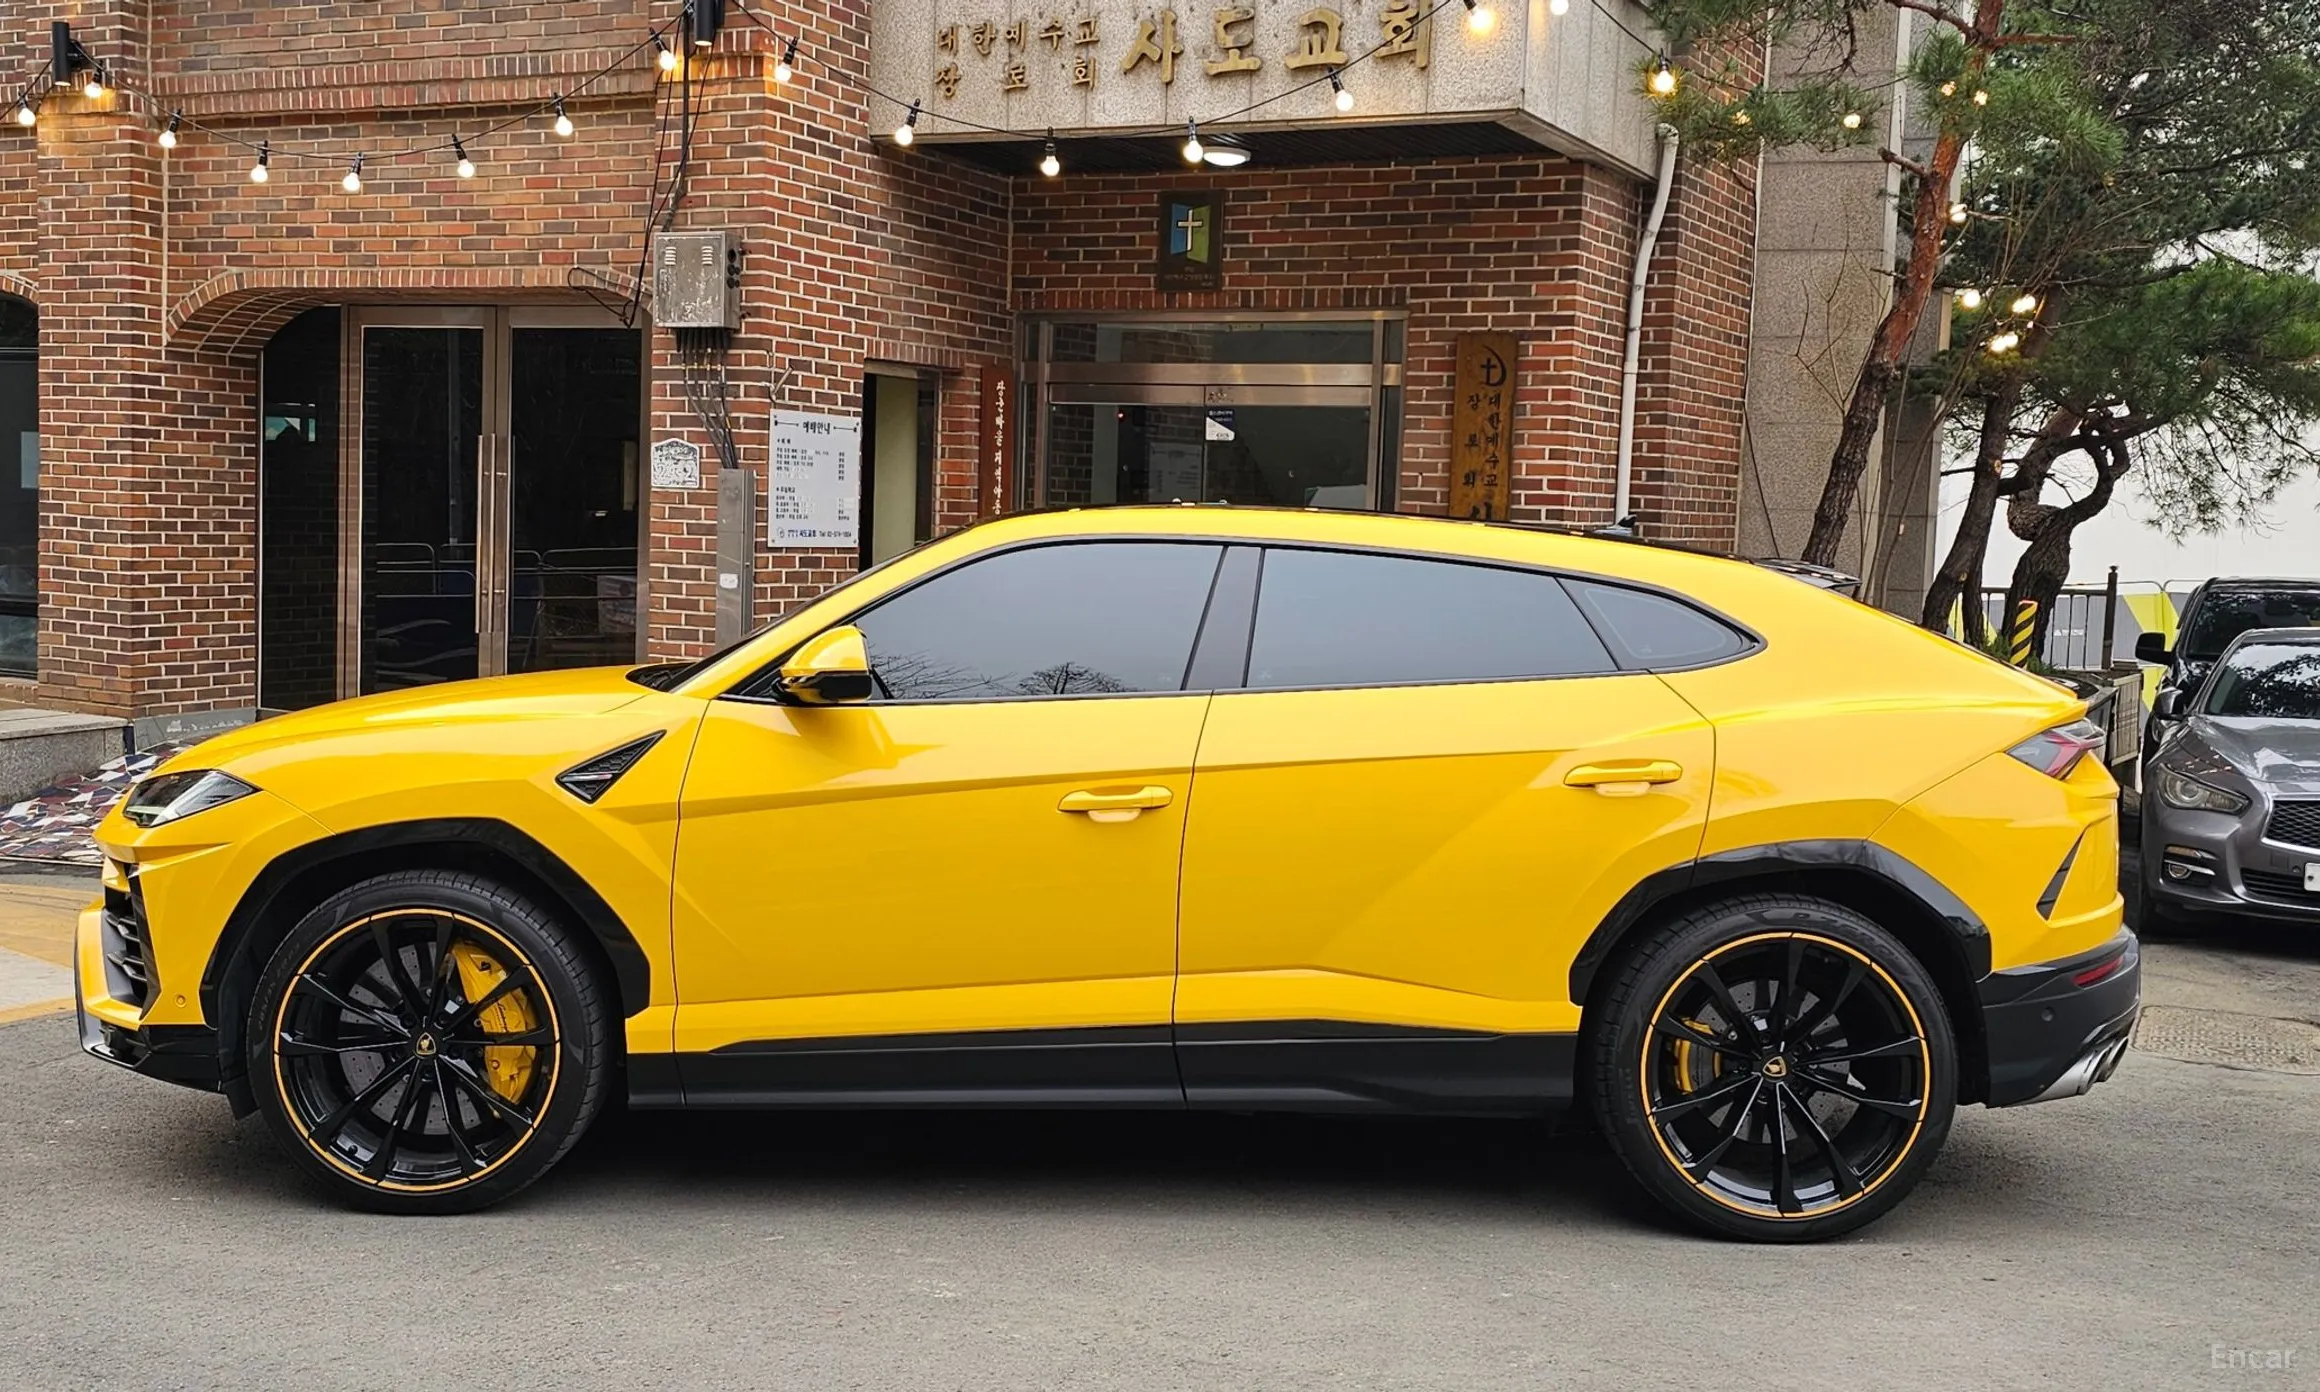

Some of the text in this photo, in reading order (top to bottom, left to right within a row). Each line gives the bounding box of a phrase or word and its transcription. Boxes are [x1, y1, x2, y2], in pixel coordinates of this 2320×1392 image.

[937, 18, 1100, 57] 대한예수교
[1120, 0, 1432, 84] 사도교회
[1483, 393, 1502, 487] 대한예수교
